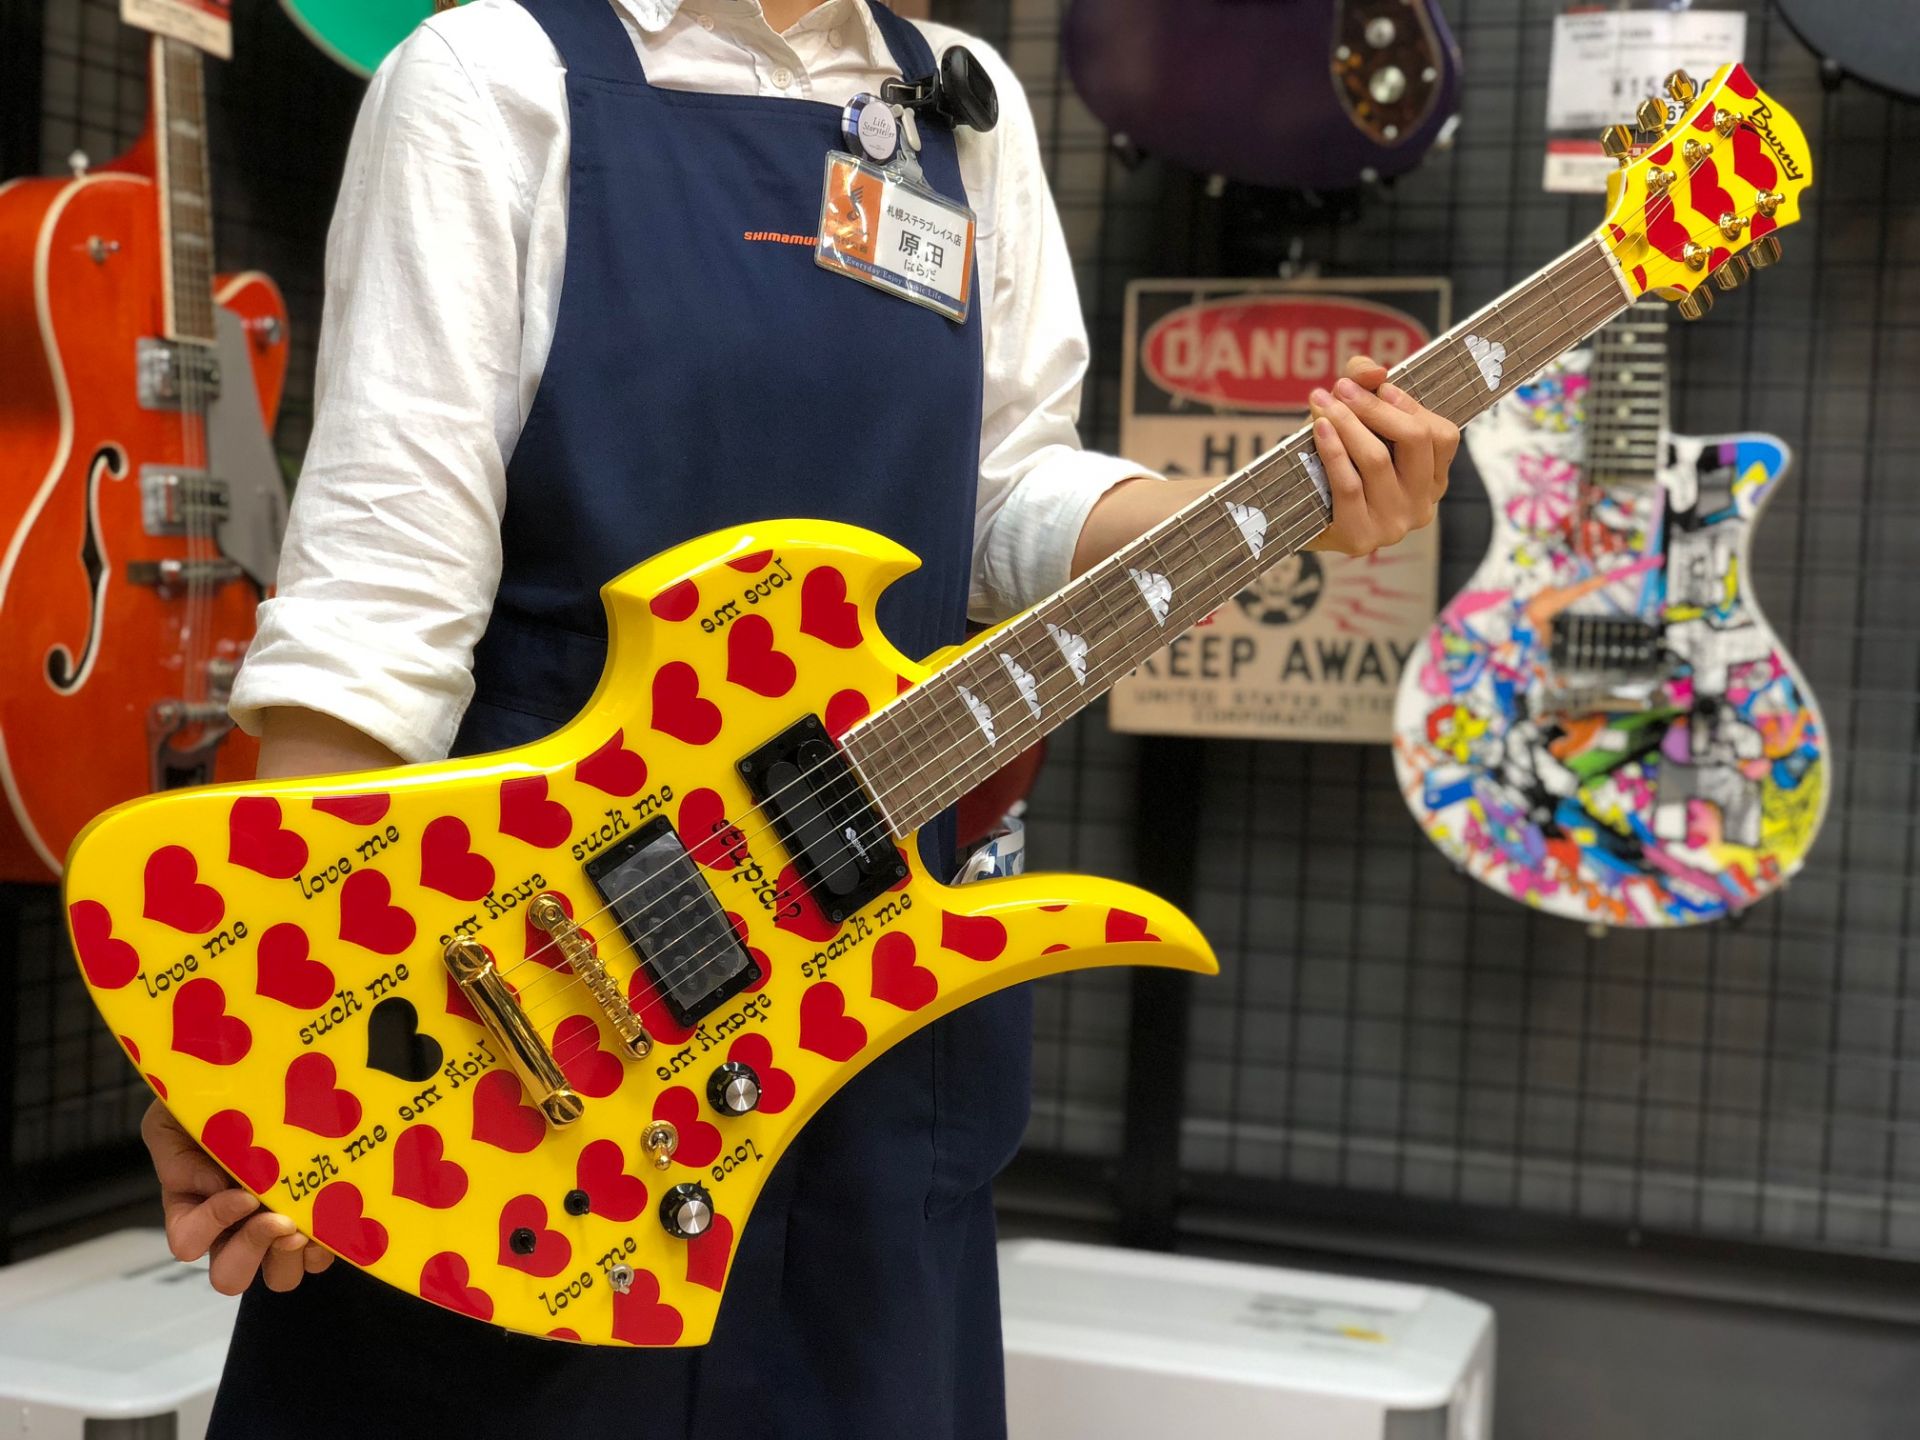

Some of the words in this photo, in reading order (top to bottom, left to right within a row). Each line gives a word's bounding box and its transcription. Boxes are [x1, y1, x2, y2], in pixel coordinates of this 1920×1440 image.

[1740, 96, 1804, 181] Burny
[898, 230, 945, 269] 原田
[1162, 325, 1410, 380] DANGER
[292, 856, 352, 900] love
[355, 824, 401, 863] me
[571, 808, 631, 862] suck
[632, 784, 675, 820] me
[137, 953, 199, 999] love
[201, 920, 249, 960] me
[800, 915, 874, 980] spank
[873, 892, 914, 929] me
[298, 989, 363, 1046] suck
[364, 962, 410, 1001] me
[281, 1154, 339, 1202] lick
[342, 1123, 389, 1163] me
[711, 1138, 764, 1182] love
[538, 1270, 593, 1317] love
[595, 1235, 637, 1274] me
